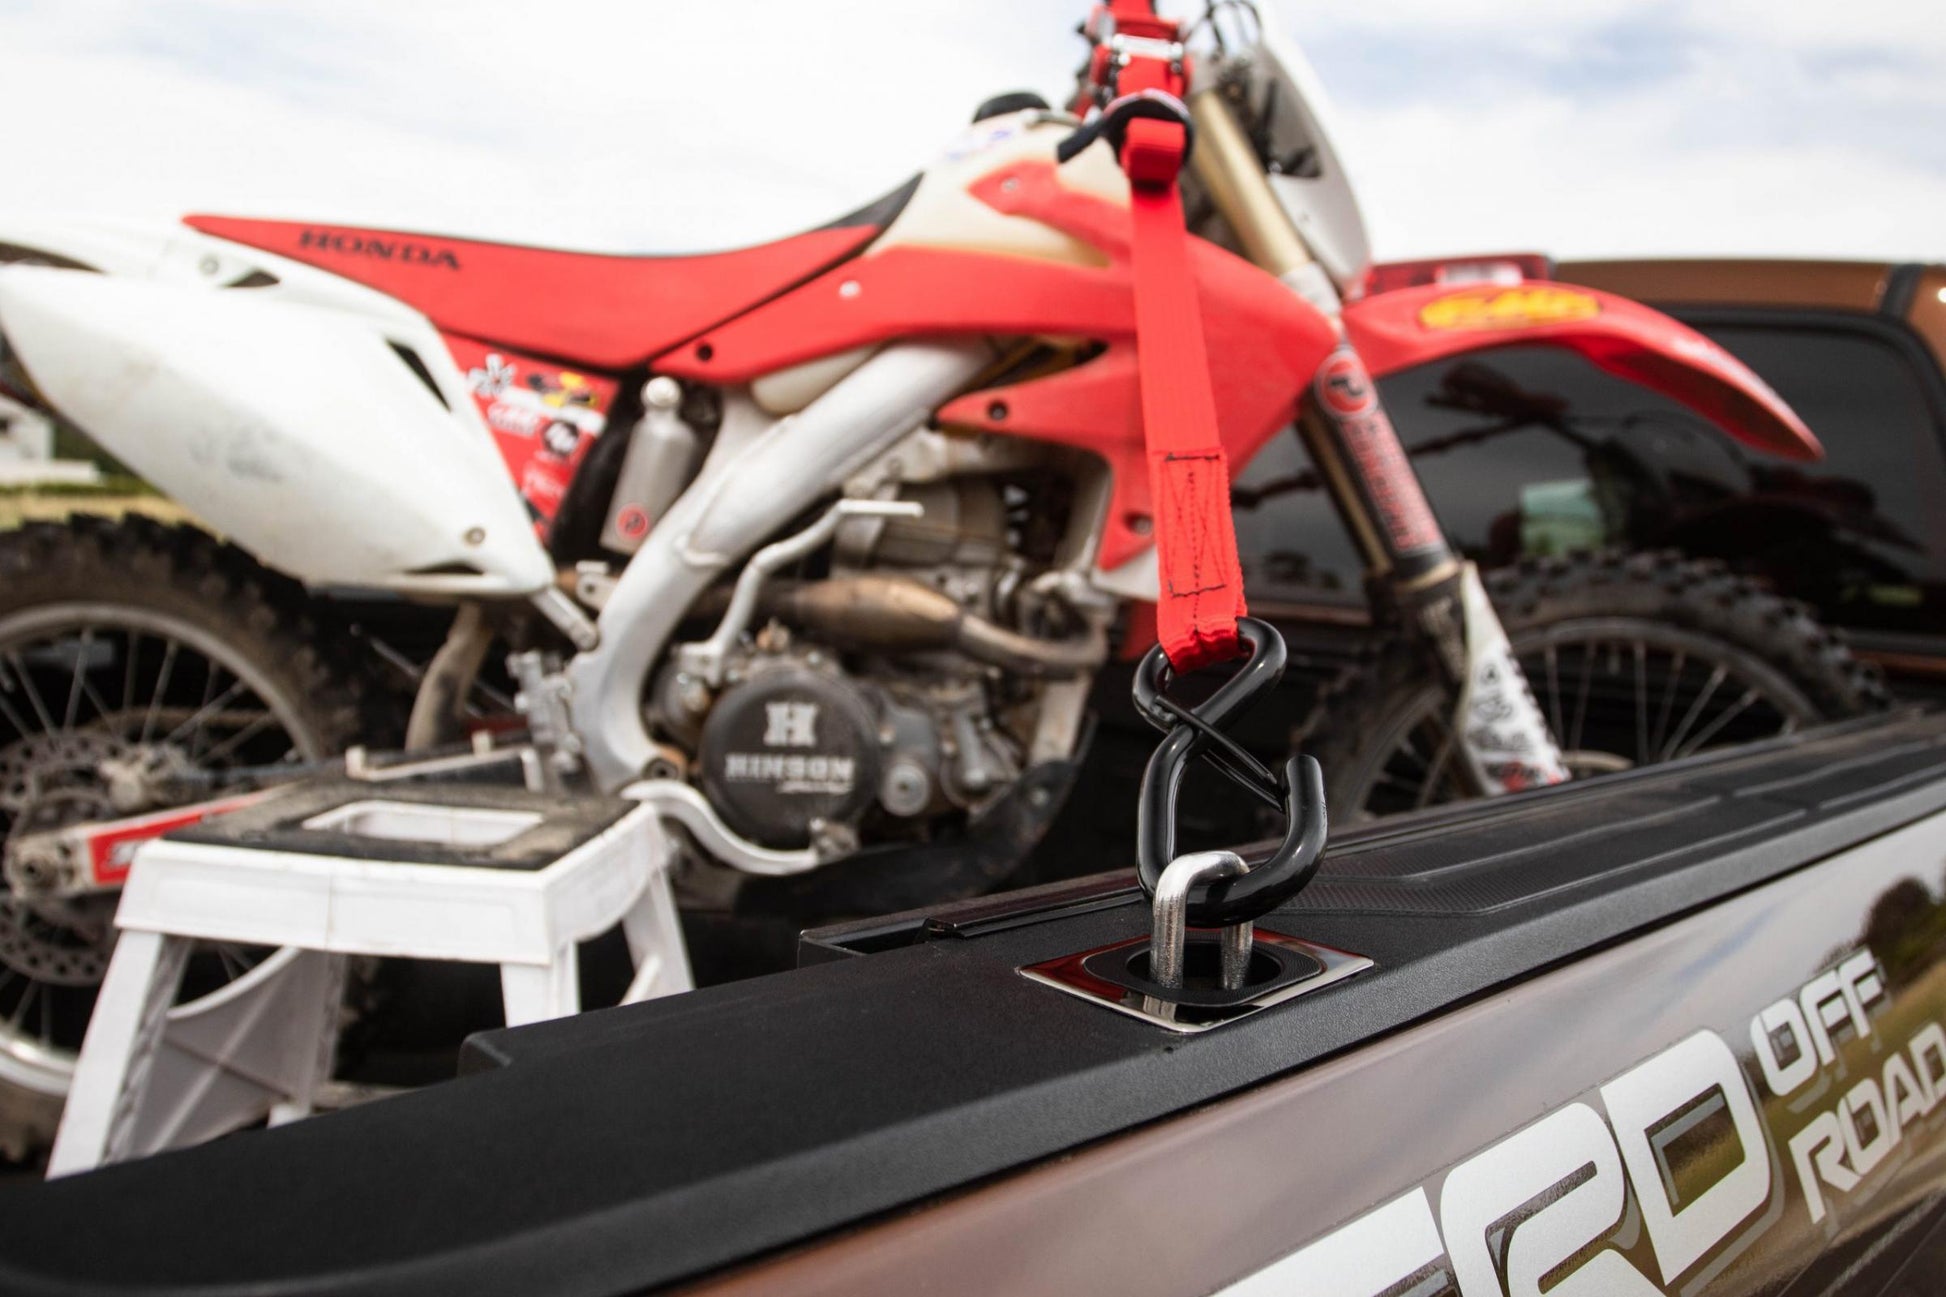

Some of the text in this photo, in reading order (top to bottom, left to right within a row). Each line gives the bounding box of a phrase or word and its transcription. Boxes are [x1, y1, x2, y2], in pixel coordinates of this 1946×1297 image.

[300, 230, 460, 270] HONDA
[1751, 948, 1883, 1097] OFF
[1788, 1022, 1946, 1225] ROAD
